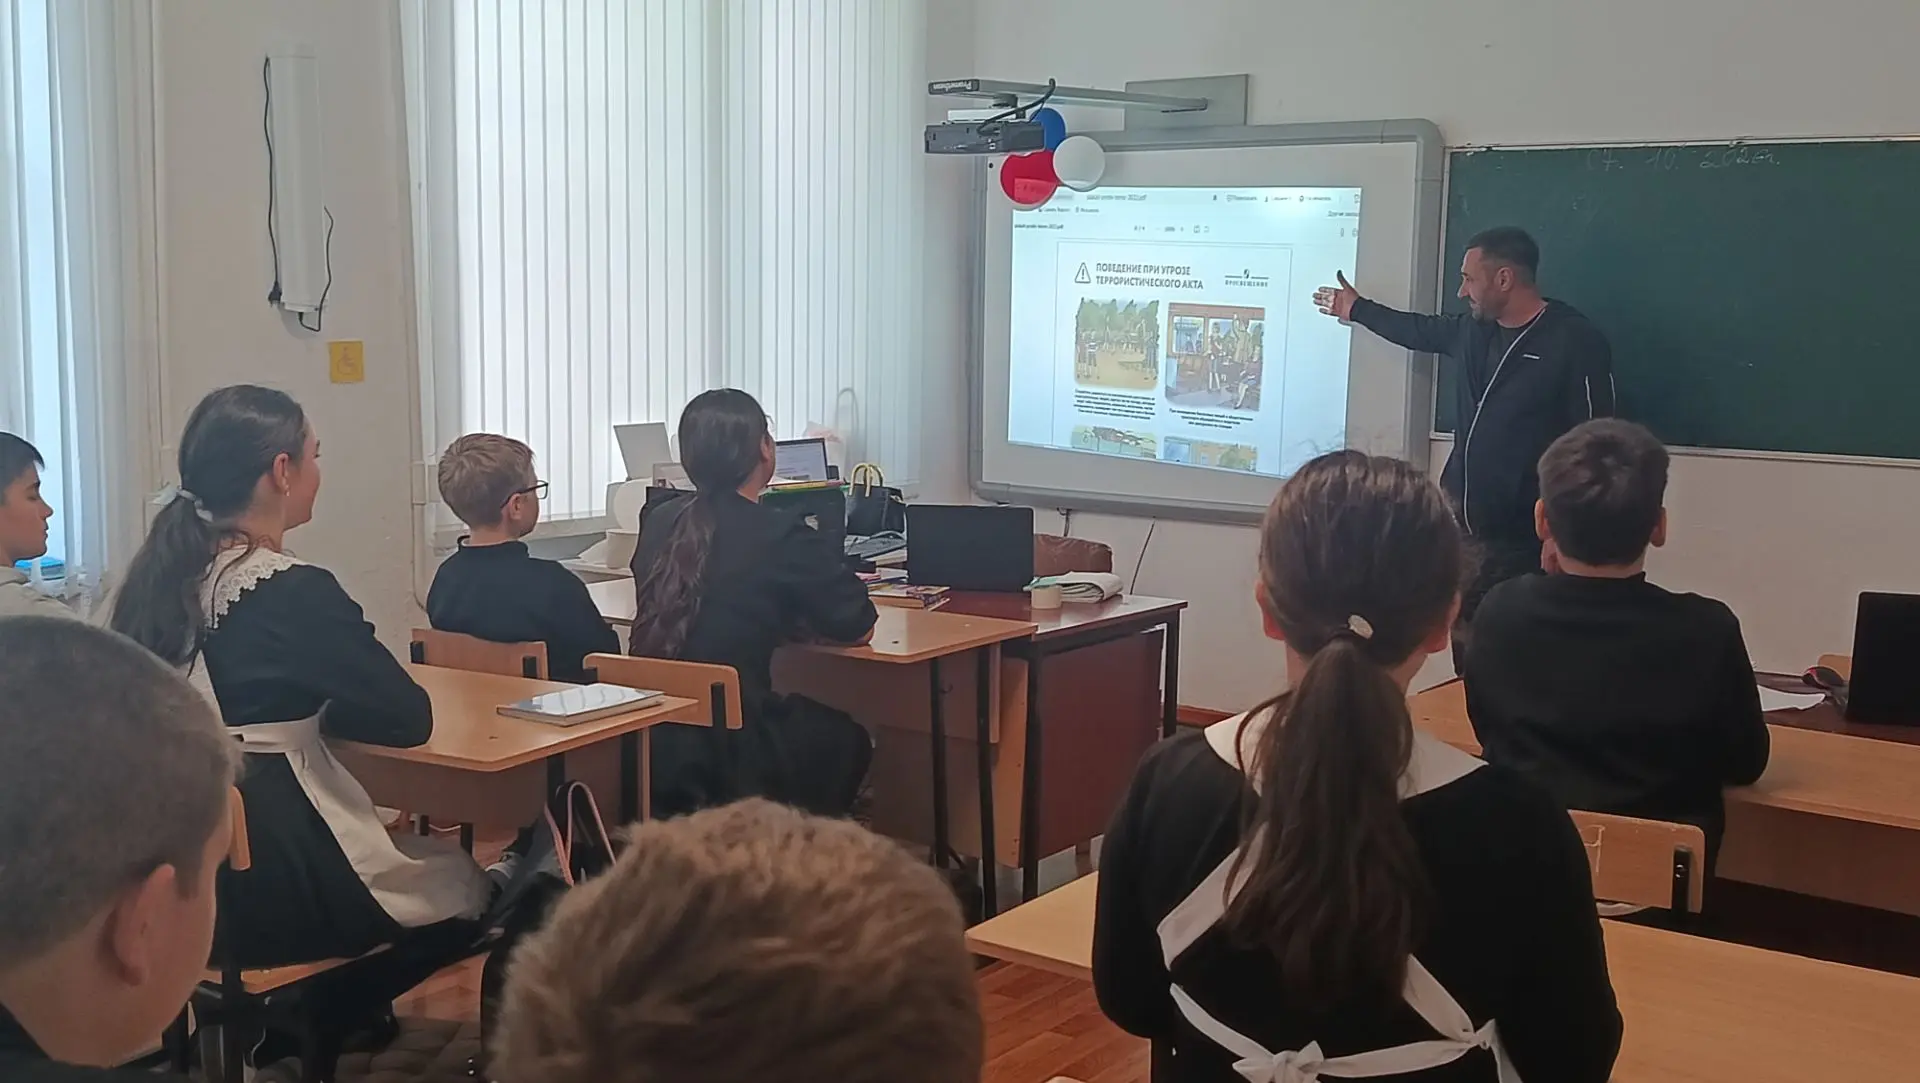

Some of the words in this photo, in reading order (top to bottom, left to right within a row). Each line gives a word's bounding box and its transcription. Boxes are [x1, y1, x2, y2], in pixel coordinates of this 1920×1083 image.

[1095, 263, 1142, 274] ПОВЕДЕНИЕ
[1143, 265, 1160, 275] ПРИ
[1161, 266, 1191, 276] УГРОЗЕ
[1095, 275, 1181, 288] ТЕРРОРИСТИЧЕСКОГО
[1182, 279, 1204, 290] АКТА
